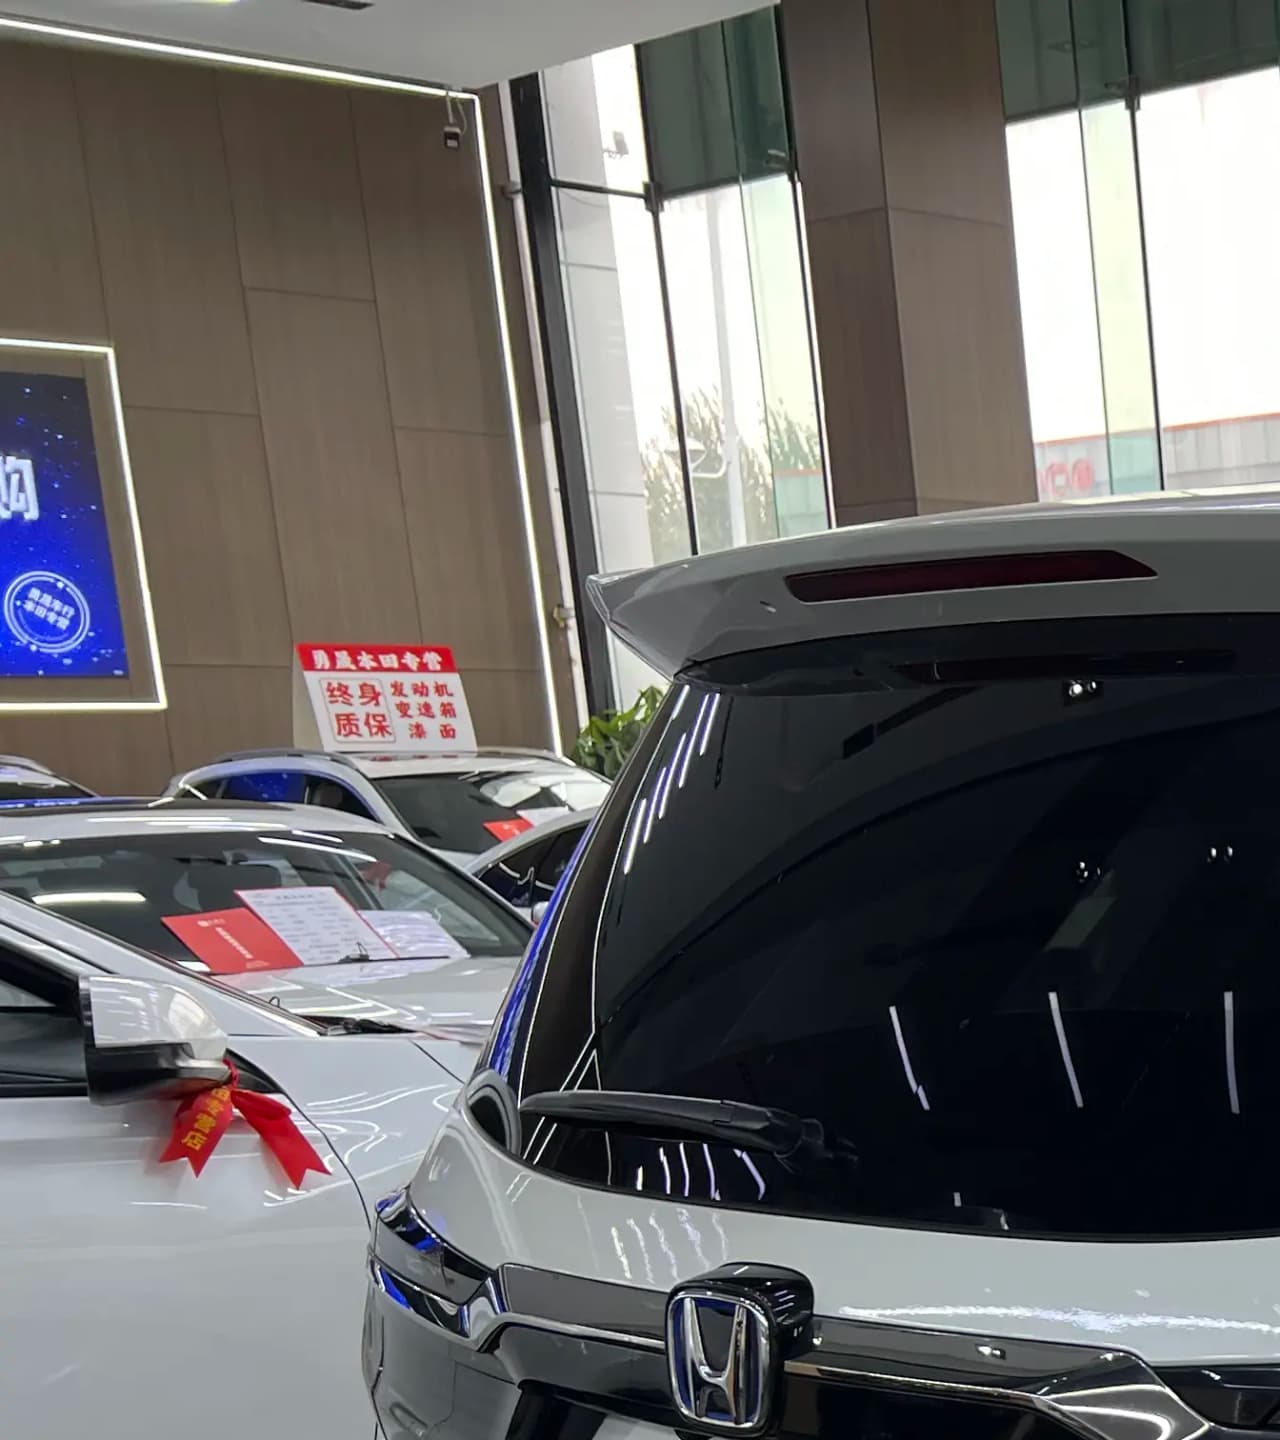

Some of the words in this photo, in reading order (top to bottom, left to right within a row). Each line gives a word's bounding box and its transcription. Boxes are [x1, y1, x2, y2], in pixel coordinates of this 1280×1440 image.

[326, 681, 381, 707] 终身
[390, 680, 453, 698] 发动机
[395, 701, 457, 720] 变速箱
[335, 712, 392, 738] 质保
